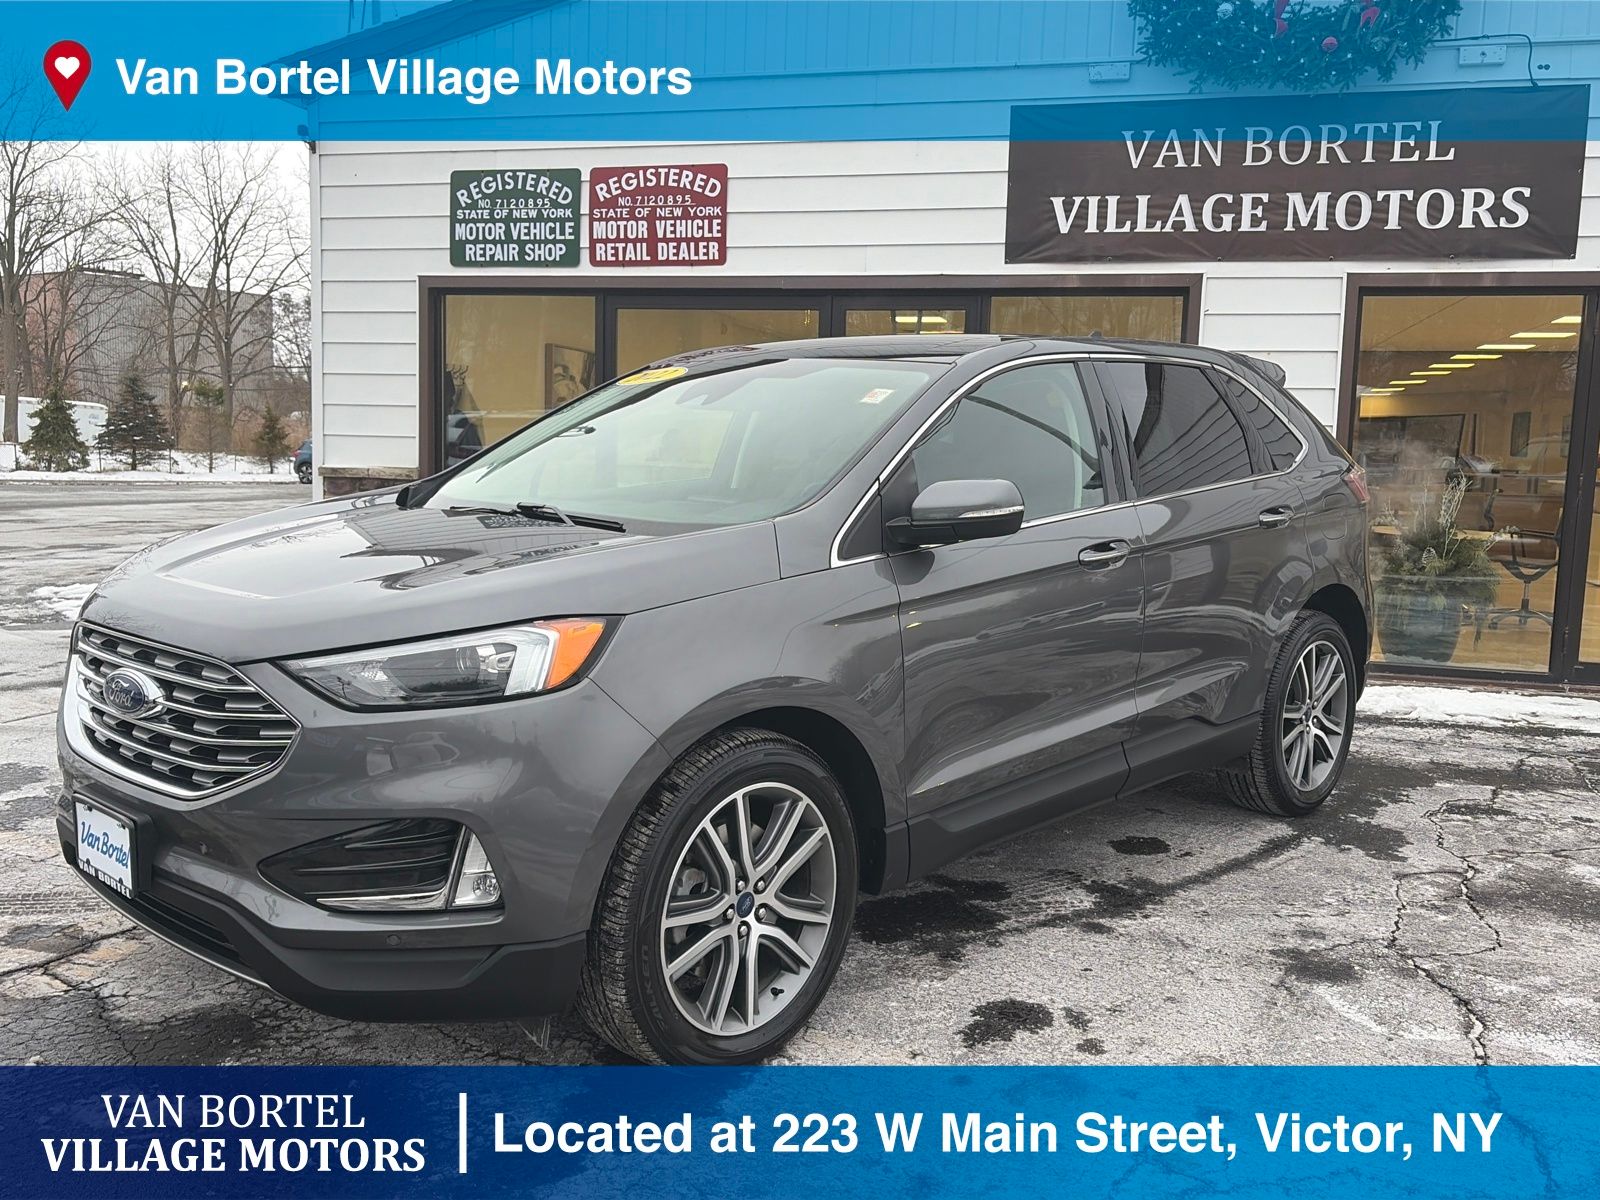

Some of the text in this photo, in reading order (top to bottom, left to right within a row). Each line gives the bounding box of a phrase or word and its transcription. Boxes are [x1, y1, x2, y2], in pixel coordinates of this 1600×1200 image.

[1123, 120, 1456, 169] VAN BORTEL
[456, 171, 573, 207] REGISTERED
[595, 168, 722, 202] REGISTERED
[478, 198, 551, 209] NO. 7120895
[618, 194, 692, 207] NO. 7120895
[1049, 187, 1532, 234] VILLAGE MOTORS
[456, 208, 573, 219] STATE OF NEW YORK
[592, 206, 722, 218] STATE OF NEW YORK
[455, 222, 575, 240] MOTOR VEHICLE
[592, 219, 722, 239] MOTOR VEHICLE
[465, 243, 566, 262] REPAIR SHOP
[595, 241, 719, 261] RETAIL DEALER
[108, 679, 135, 708] Ford
[81, 821, 130, 869] Van Bortel
[97, 868, 132, 899] BORTEL
